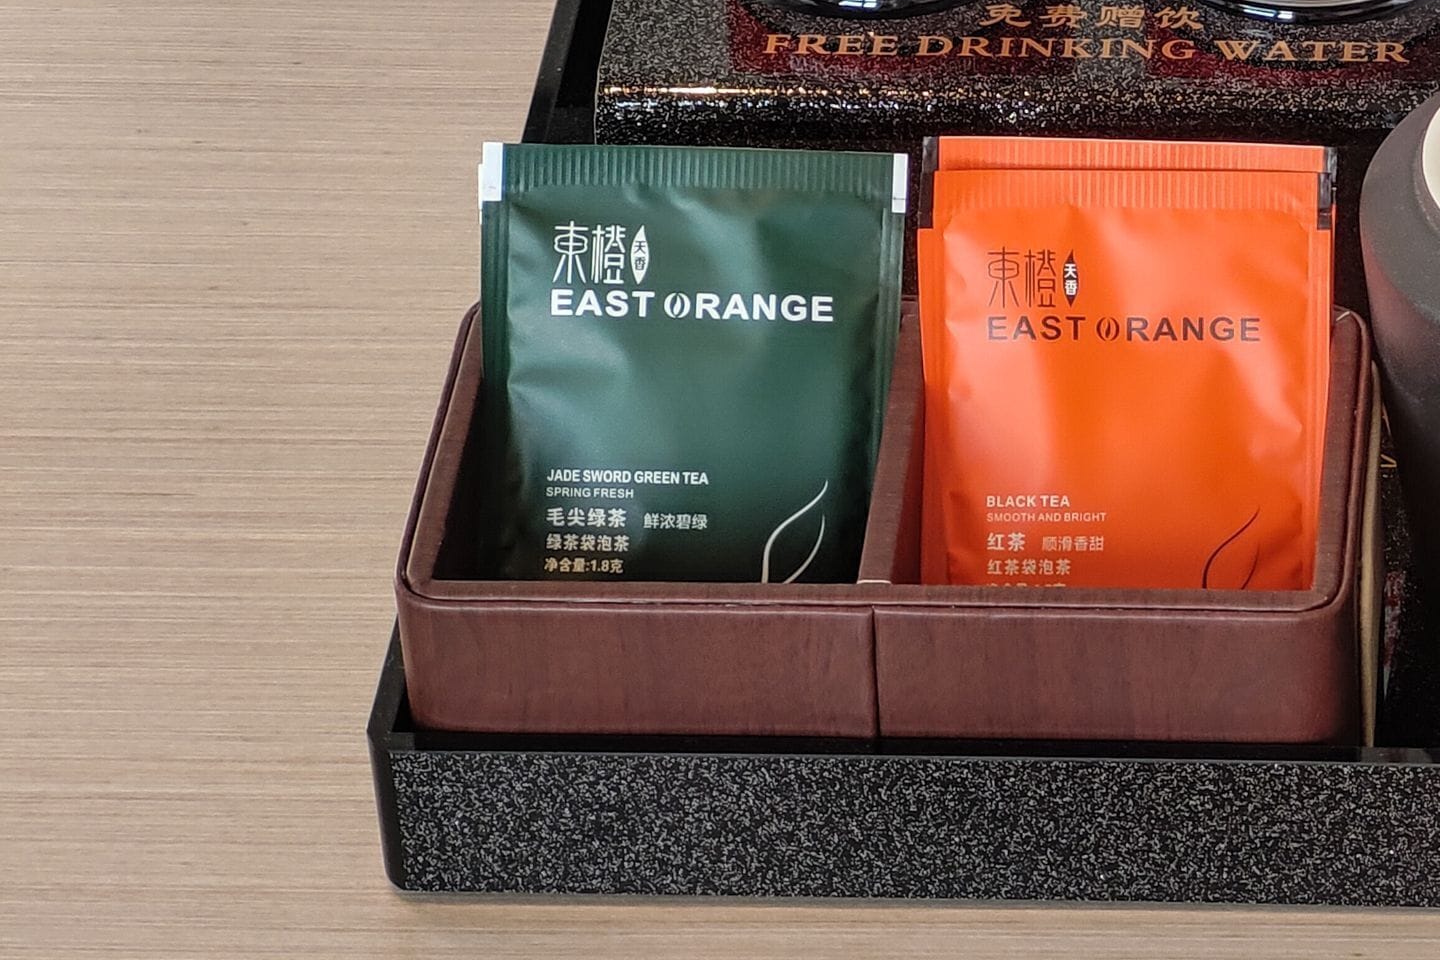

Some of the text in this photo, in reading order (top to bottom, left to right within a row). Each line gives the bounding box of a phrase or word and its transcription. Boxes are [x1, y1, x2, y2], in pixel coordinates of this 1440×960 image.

[979, 3, 1204, 30] 免费赠饮
[763, 33, 1411, 64] FREE DRINKING WATER
[633, 240, 647, 272] 天香
[1063, 263, 1078, 296] 天香
[551, 289, 834, 322] EAST ORANGE
[987, 315, 1261, 342] EAST ORANGE
[546, 469, 709, 485] JADE SWORD GREEN TEA
[546, 486, 634, 499] SPRING FRESH
[986, 495, 1070, 508] BLACK TEA
[546, 507, 708, 530] 毛尖绿茶 鲜浓碧绿
[986, 512, 1107, 522] SMOOTH AND BRIGHT
[546, 533, 630, 552] 绿茶袋泡茶
[987, 532, 1104, 552] 红茶 顺滑香甜
[544, 557, 624, 574] 净含量:1.8克
[986, 559, 1071, 576] 红茶袋泡茶
